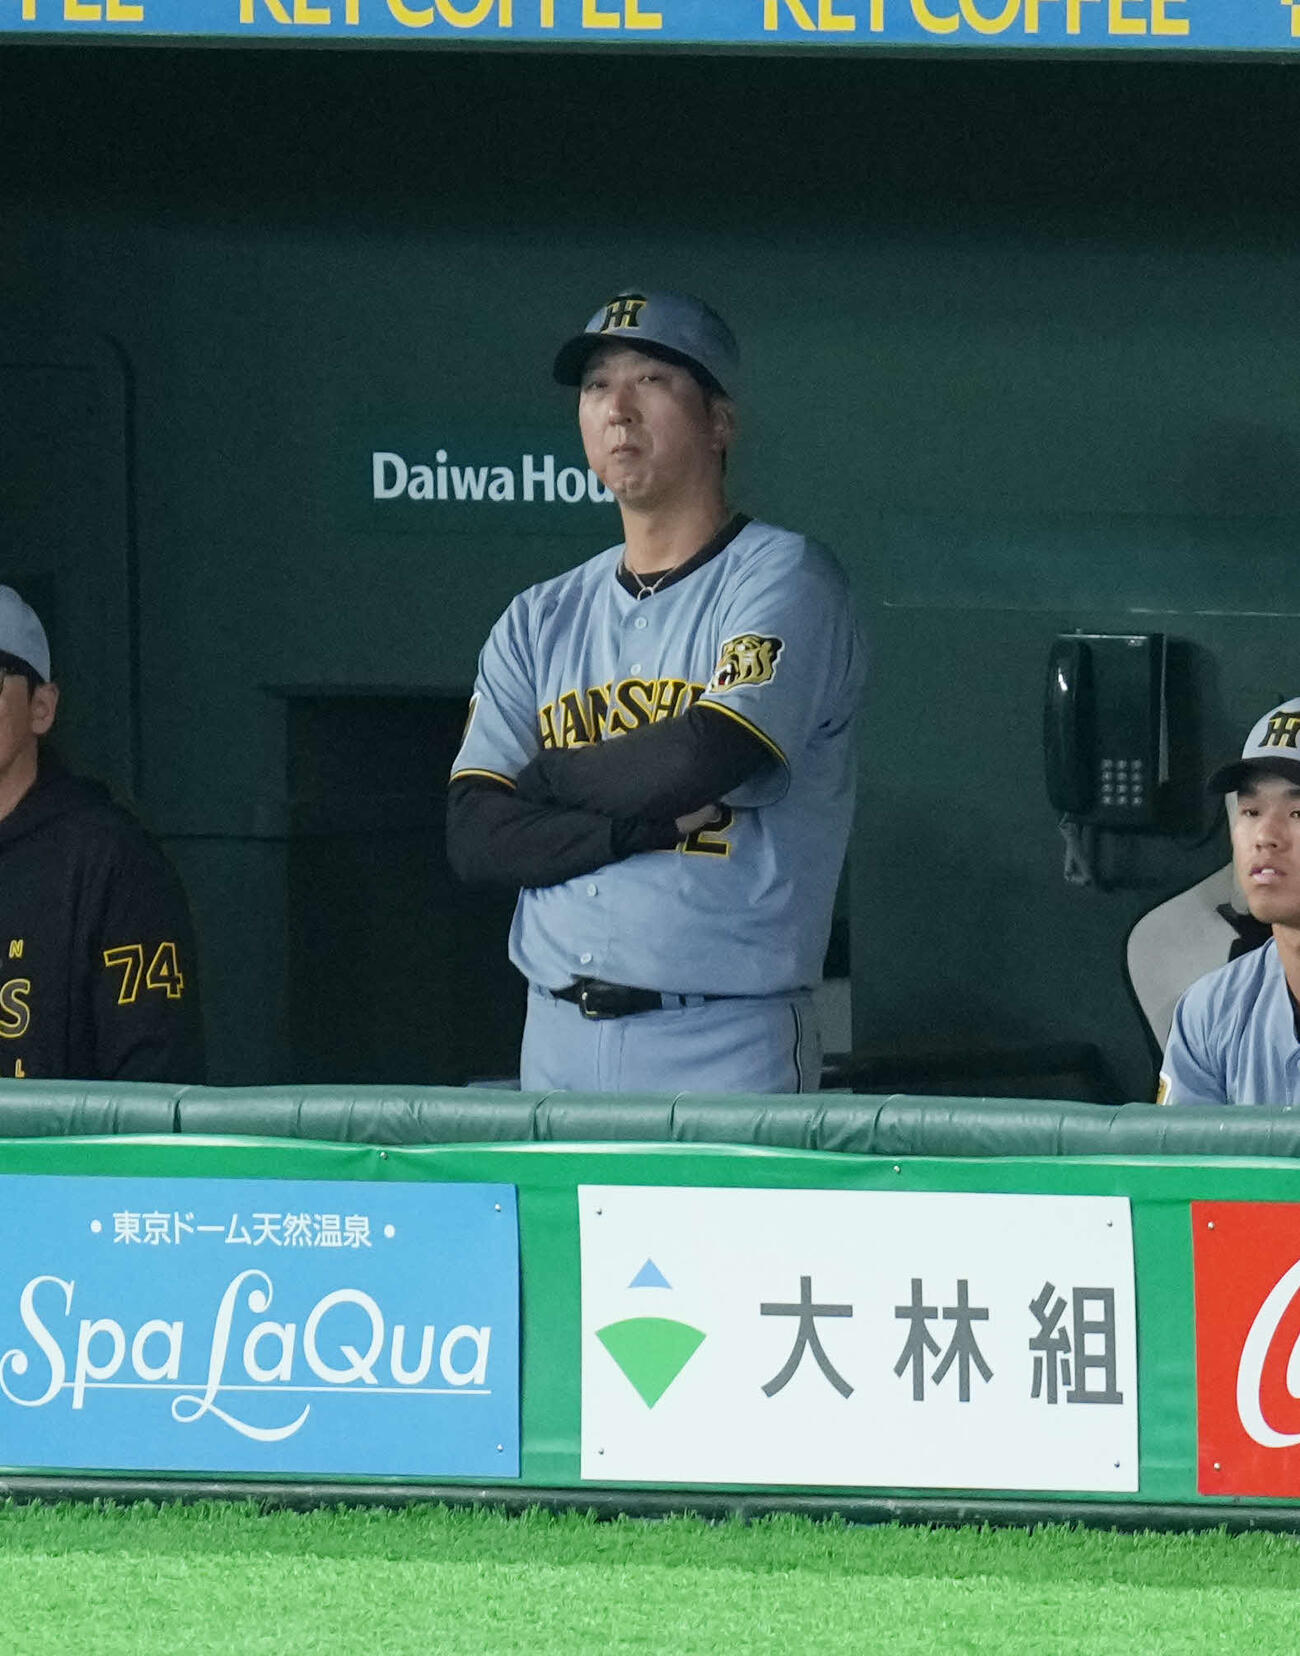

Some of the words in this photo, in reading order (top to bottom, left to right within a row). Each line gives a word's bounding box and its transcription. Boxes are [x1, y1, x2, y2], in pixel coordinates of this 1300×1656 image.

[372, 449, 515, 501] Daiwa
[103, 941, 184, 1005] 74
[112, 1210, 372, 1249] 東京ドーム天然温泉
[0, 1275, 184, 1410] Spa
[171, 1269, 492, 1442] LaQua
[759, 1275, 1124, 1405] 大林組
